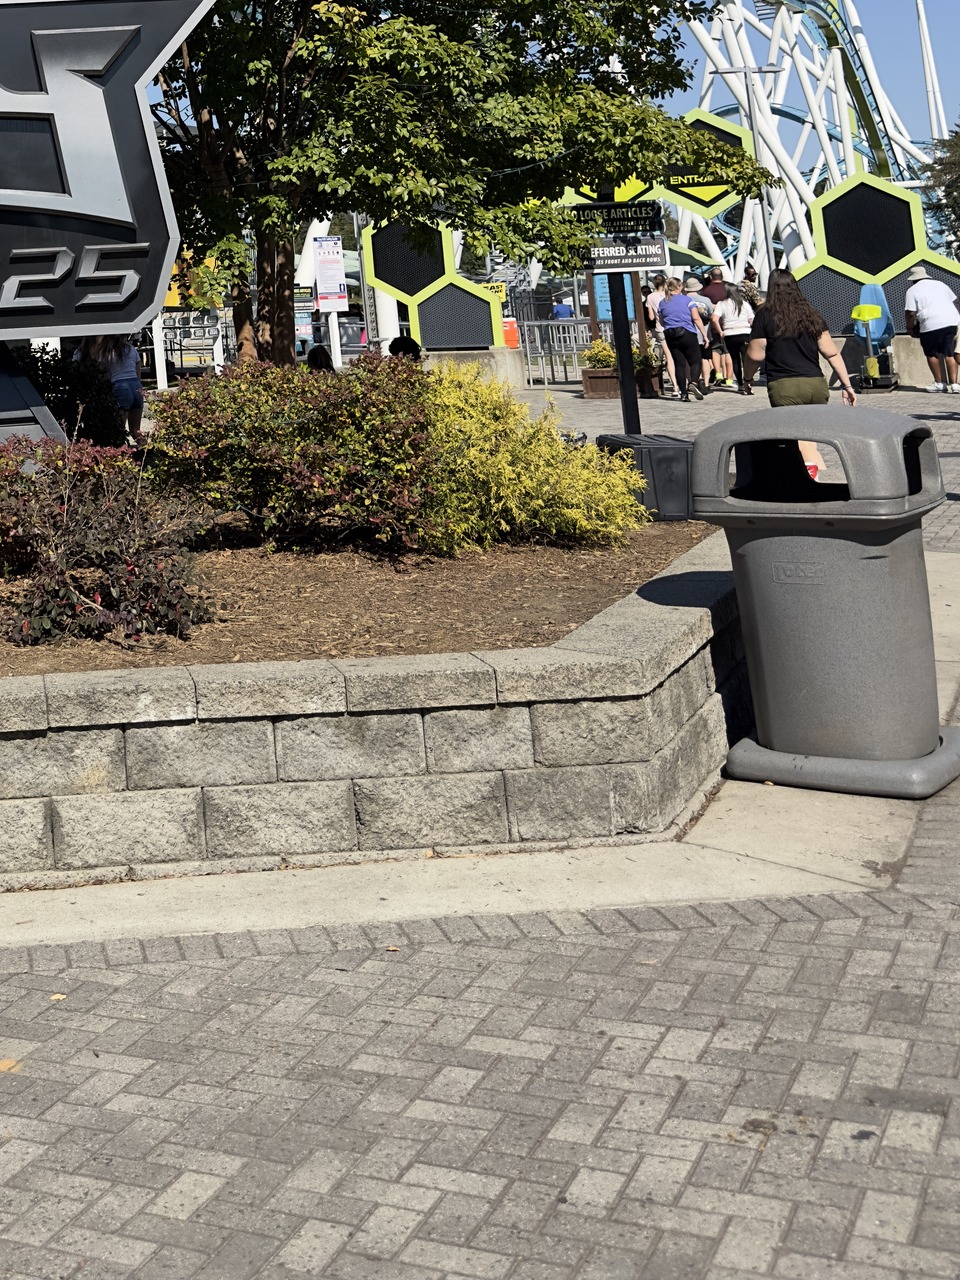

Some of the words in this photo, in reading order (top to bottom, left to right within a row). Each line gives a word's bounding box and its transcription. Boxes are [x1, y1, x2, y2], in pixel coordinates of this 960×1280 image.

[580, 209, 609, 220] LOOSE
[610, 206, 653, 219] ARTICLES
[627, 244, 662, 256] SEATING
